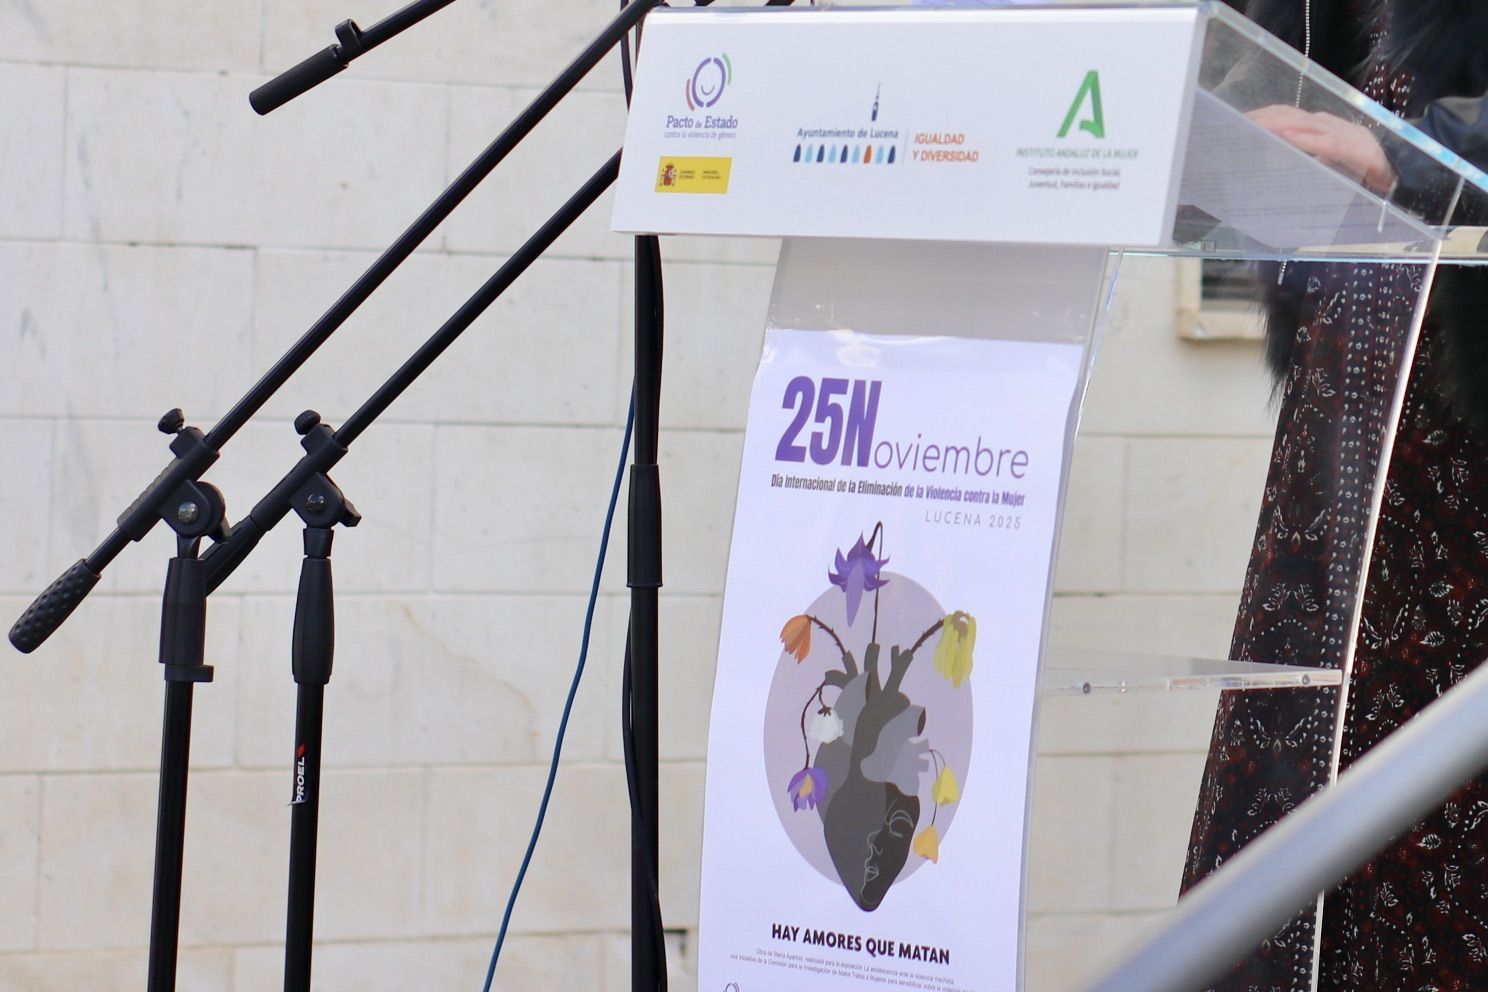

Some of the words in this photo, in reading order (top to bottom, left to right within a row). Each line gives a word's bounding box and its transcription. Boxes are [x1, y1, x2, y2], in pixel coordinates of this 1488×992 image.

[666, 115, 694, 129] Pacto
[695, 120, 702, 129] de
[704, 115, 739, 129] Estado
[797, 128, 856, 142] Ayuntamiento
[857, 128, 868, 139] de
[870, 128, 899, 139] Lucena
[914, 133, 966, 146] IGUALDAD
[912, 150, 921, 161] Y
[921, 150, 980, 163] DIVERSIDAD
[771, 473, 784, 488] Día
[785, 475, 836, 492] Internacional
[837, 479, 847, 493] de
[848, 480, 856, 493] la
[858, 480, 903, 497] Eliminación
[904, 484, 915, 498] de
[916, 485, 924, 499] la
[926, 485, 961, 502] Violencia
[963, 489, 990, 504] contra
[992, 491, 1000, 504] la
[1001, 491, 1025, 507] Mujer
[925, 510, 981, 526] LUCENA
[989, 514, 1021, 529] 2025
[295, 756, 305, 802] PROEL
[772, 923, 800, 943] HAY
[802, 928, 862, 952] AMORES
[866, 938, 895, 957] QUE
[899, 942, 950, 966] MATAN
